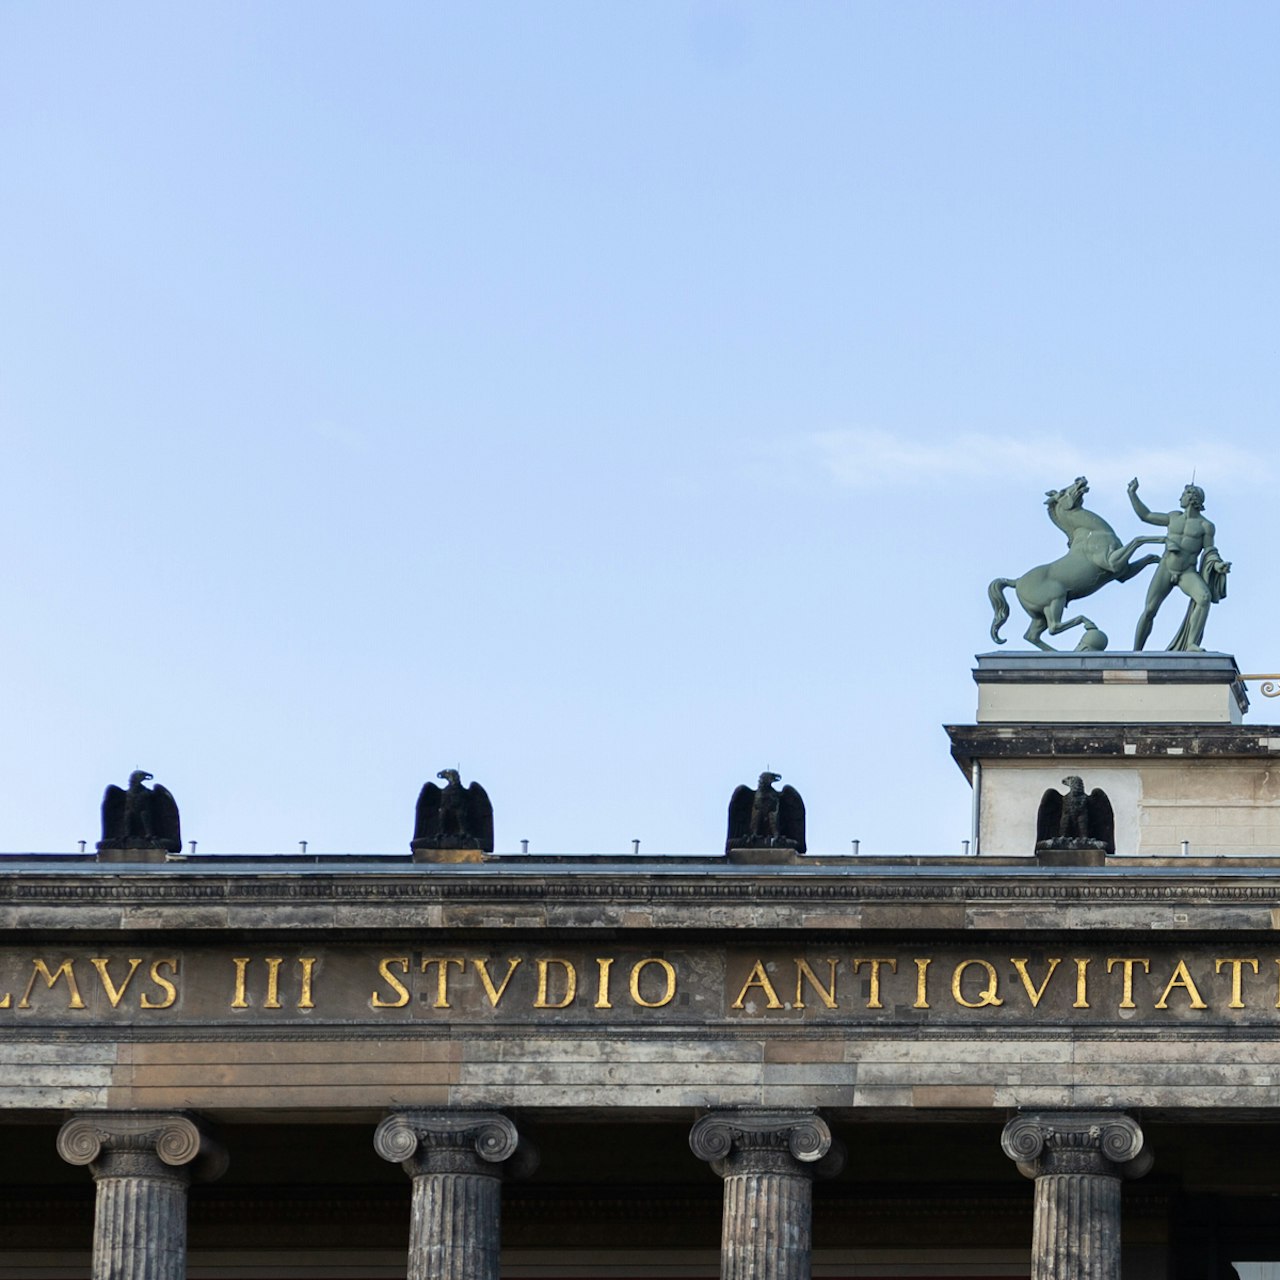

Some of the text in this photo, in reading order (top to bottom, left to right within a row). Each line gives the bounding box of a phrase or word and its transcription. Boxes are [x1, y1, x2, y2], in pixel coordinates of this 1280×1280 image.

[0, 958, 179, 1009] MVS
[231, 957, 316, 1009] III
[371, 957, 677, 1009] STVDIO
